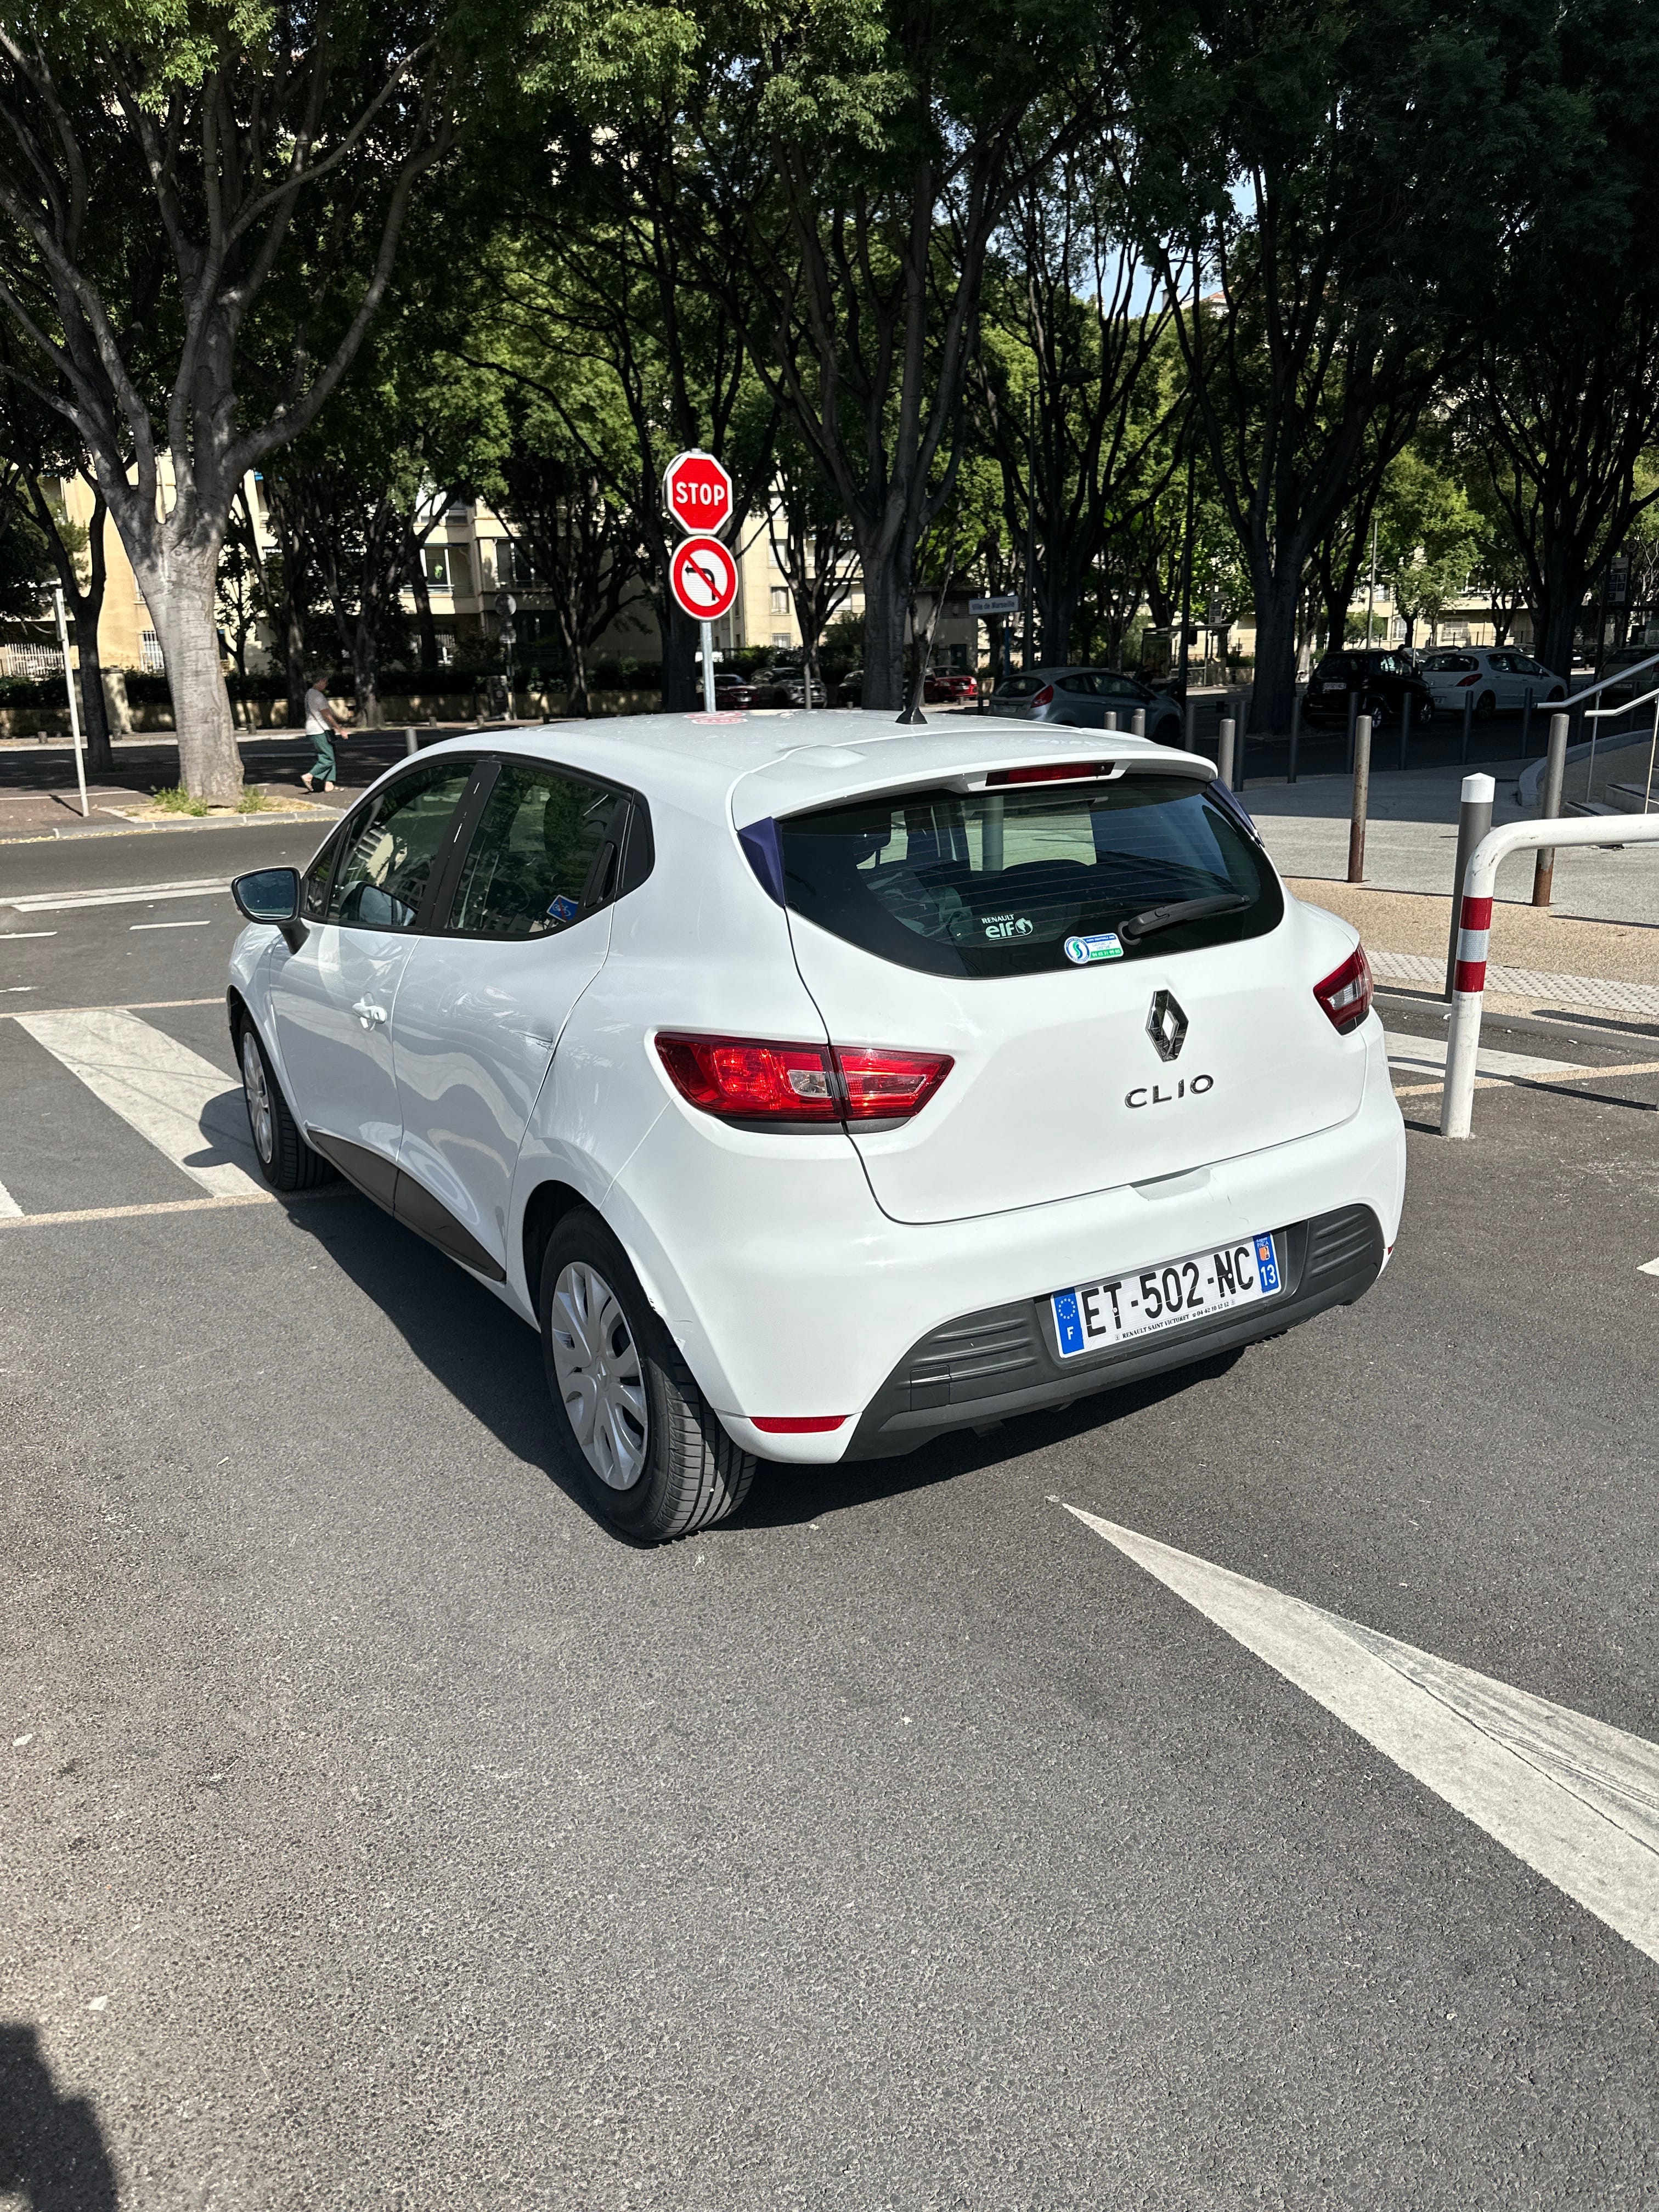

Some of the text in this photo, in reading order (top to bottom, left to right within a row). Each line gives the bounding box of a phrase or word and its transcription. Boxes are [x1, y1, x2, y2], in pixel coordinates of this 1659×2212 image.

[675, 482, 725, 506] STOP
[981, 914, 1014, 924] RENAULT
[985, 921, 1014, 938] elf
[1125, 1074, 1214, 1108] CLIO
[1261, 1264, 1276, 1286] 13
[1081, 1246, 1254, 1338] ET-502-NC
[1066, 1326, 1074, 1340] F
[1122, 1327, 1147, 1339] RENAULT
[1148, 1322, 1164, 1331] SAINT
[1165, 1314, 1189, 1326] VICTORET
